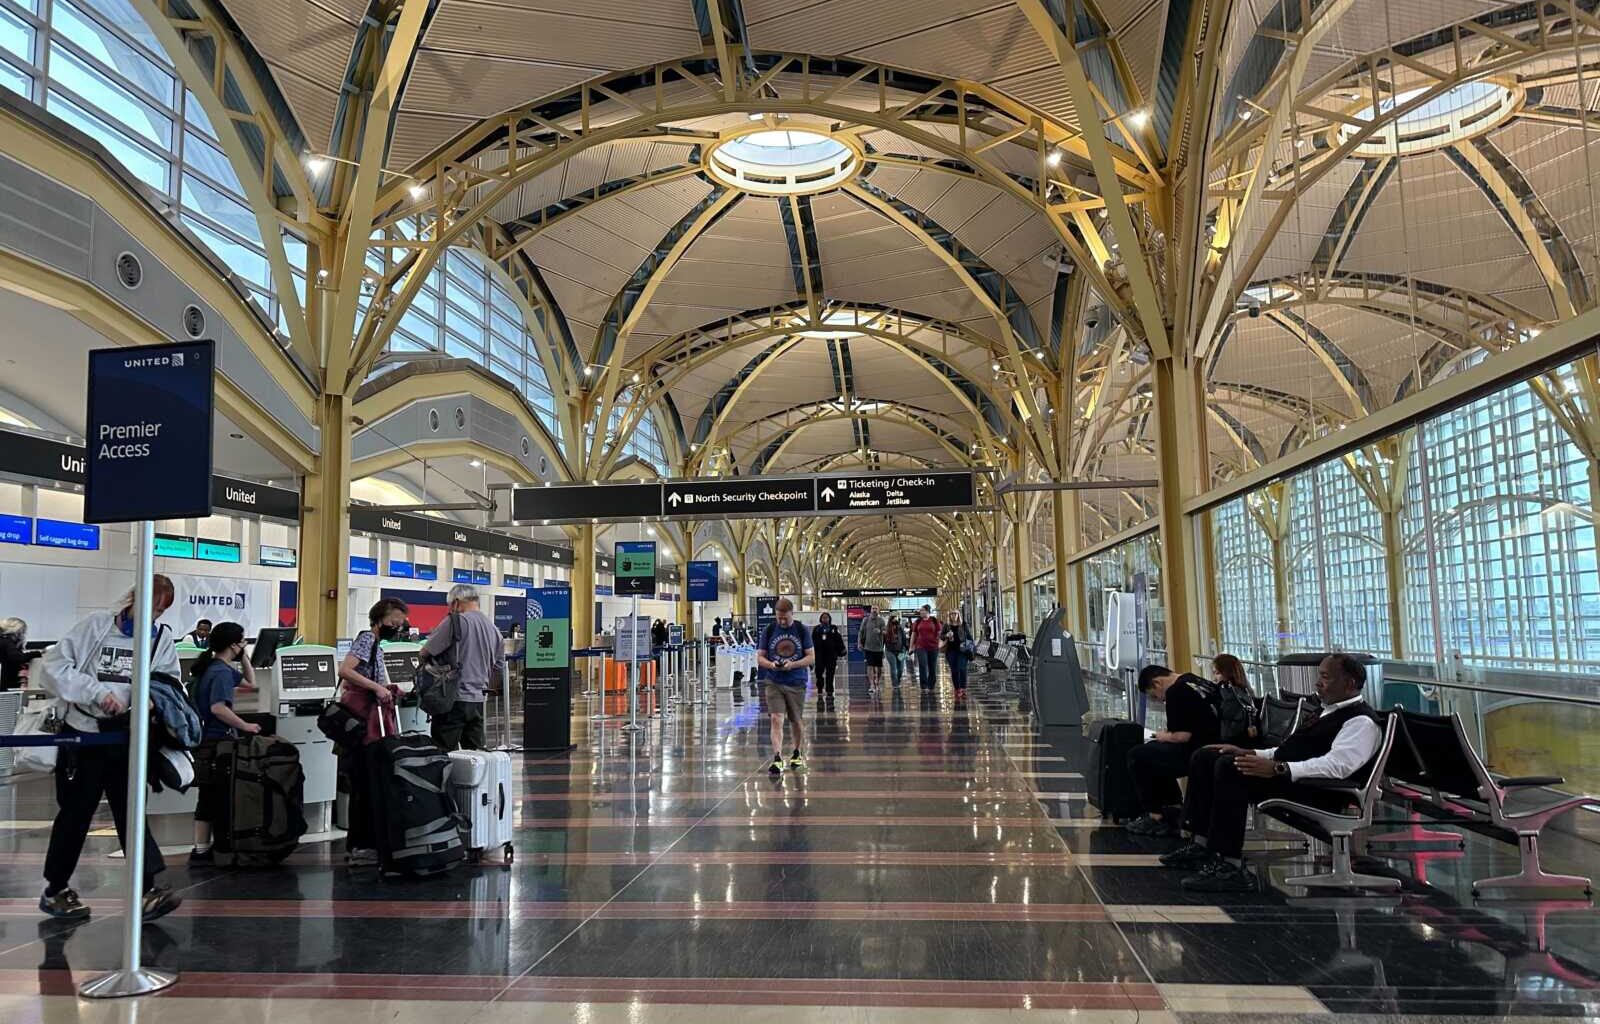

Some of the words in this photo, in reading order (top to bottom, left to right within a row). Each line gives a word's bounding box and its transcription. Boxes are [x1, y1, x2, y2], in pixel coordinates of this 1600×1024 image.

[123, 357, 170, 368] UNITED
[100, 421, 162, 440] Premier
[98, 443, 151, 460] Access
[61, 454, 87, 474] Uni
[849, 480, 890, 490] Ticketing
[896, 477, 936, 488] Check-In
[225, 486, 256, 505] United
[695, 493, 720, 503] North
[722, 493, 757, 503] Security
[758, 491, 807, 502] Checkpoint
[849, 491, 871, 499] Alaska
[849, 499, 880, 507] American
[886, 498, 910, 506] JetBlue
[382, 516, 401, 530] United
[454, 531, 467, 542] Delta
[508, 542, 519, 551] Delta
[189, 595, 233, 606] UNITED
